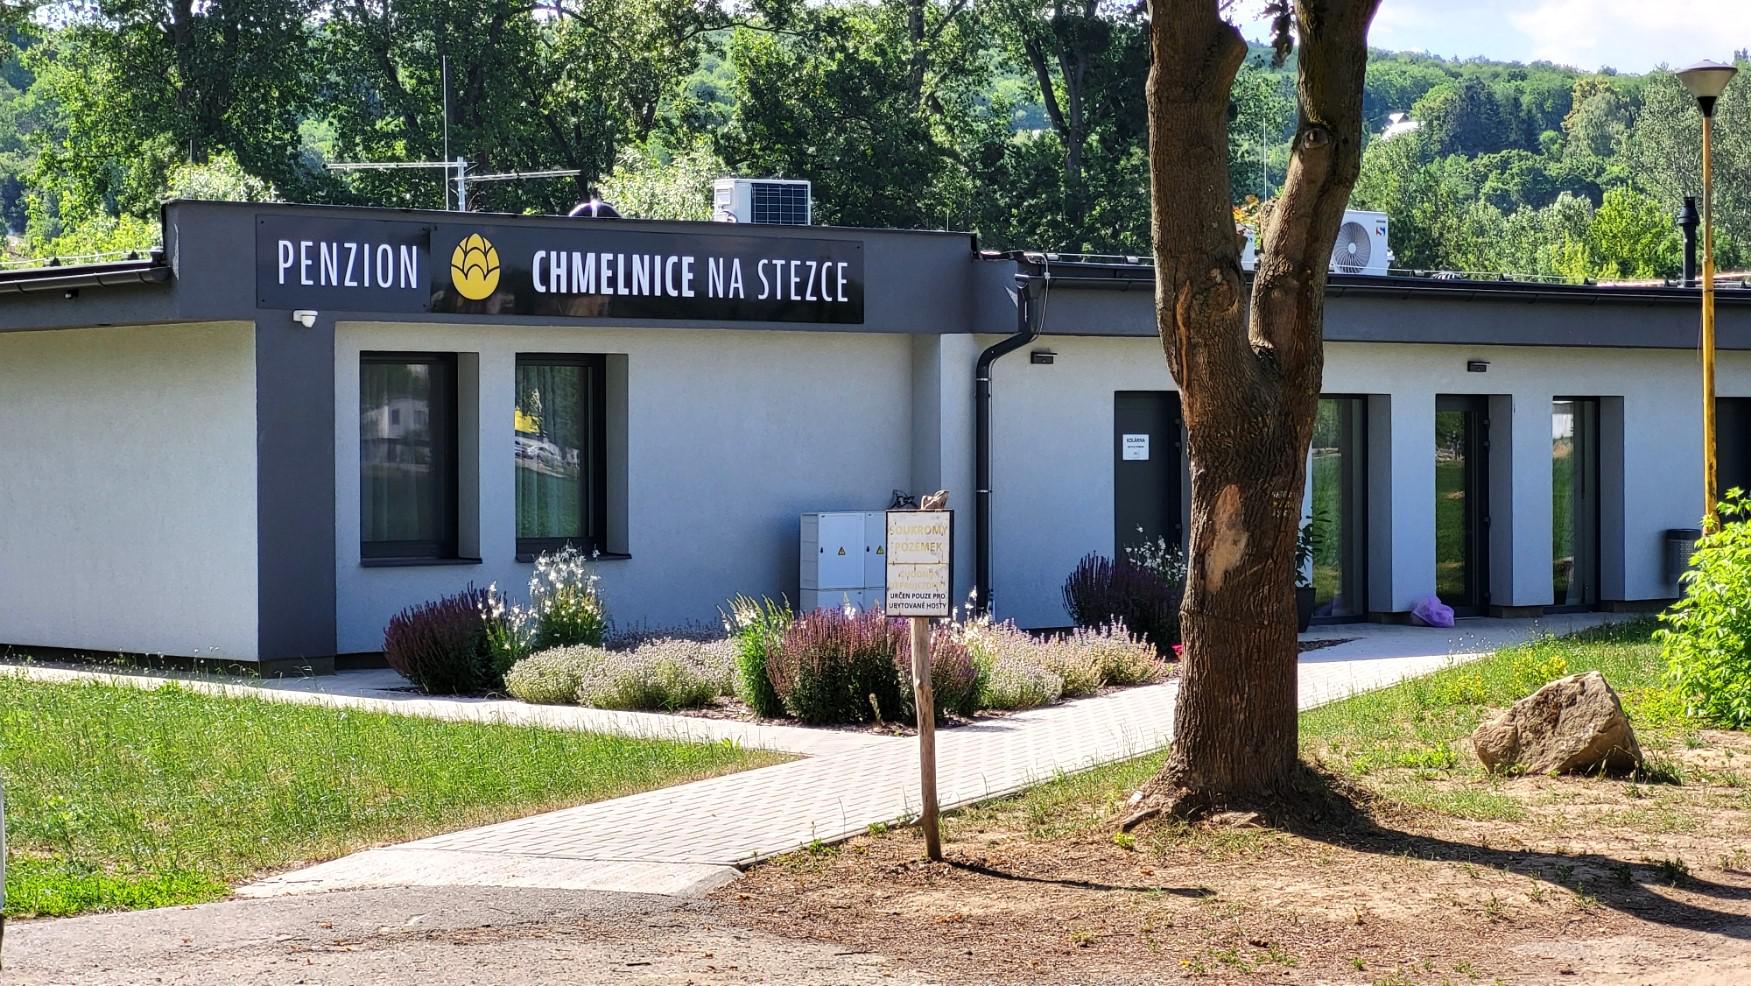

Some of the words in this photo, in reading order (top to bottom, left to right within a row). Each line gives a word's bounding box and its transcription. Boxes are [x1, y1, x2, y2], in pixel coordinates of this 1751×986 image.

[278, 240, 417, 289] PENZION
[532, 250, 695, 297] CHMELNICE
[708, 257, 745, 299] NA
[757, 259, 849, 302] STEZCE
[895, 542, 943, 552] POZEMEK
[889, 601, 925, 609] UBYTOVANÉ
